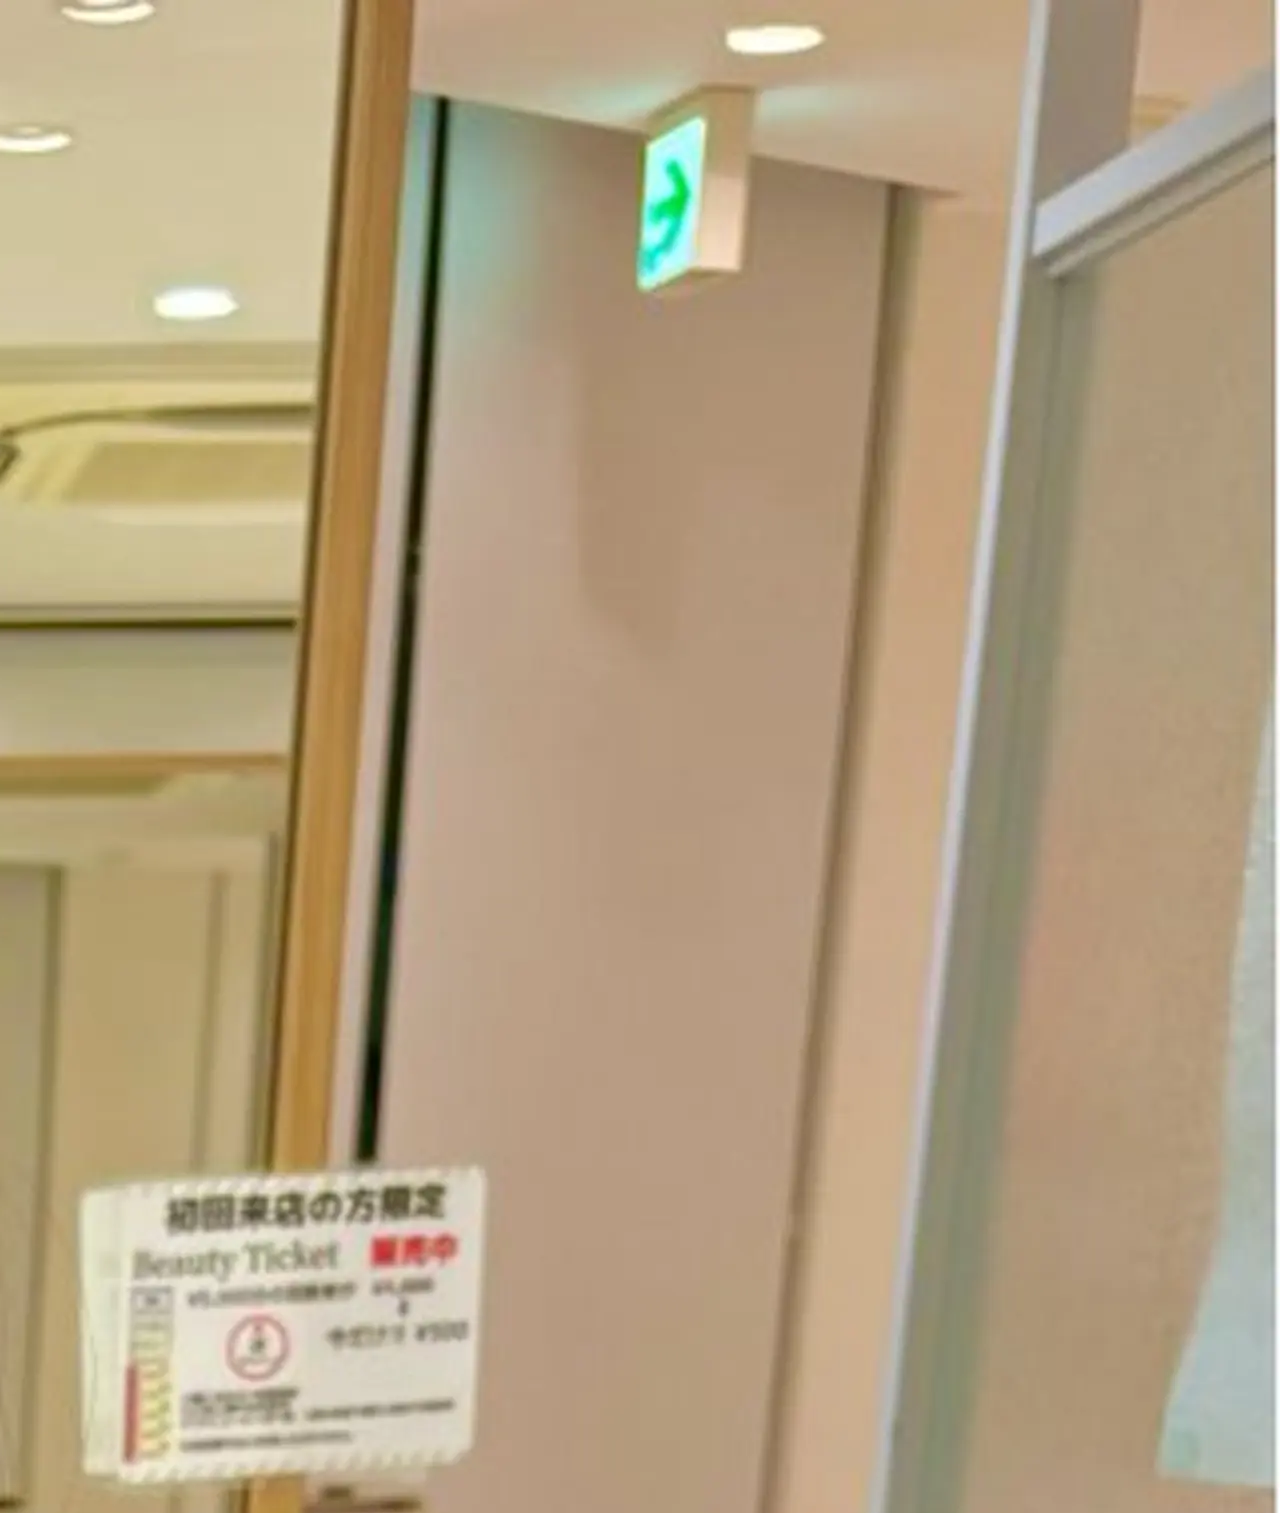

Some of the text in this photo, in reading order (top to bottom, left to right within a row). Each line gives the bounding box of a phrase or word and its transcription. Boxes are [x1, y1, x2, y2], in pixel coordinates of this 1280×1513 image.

[167, 1183, 445, 1234] 初回来店の方限定
[134, 1239, 339, 1282] Beauty Ticket
